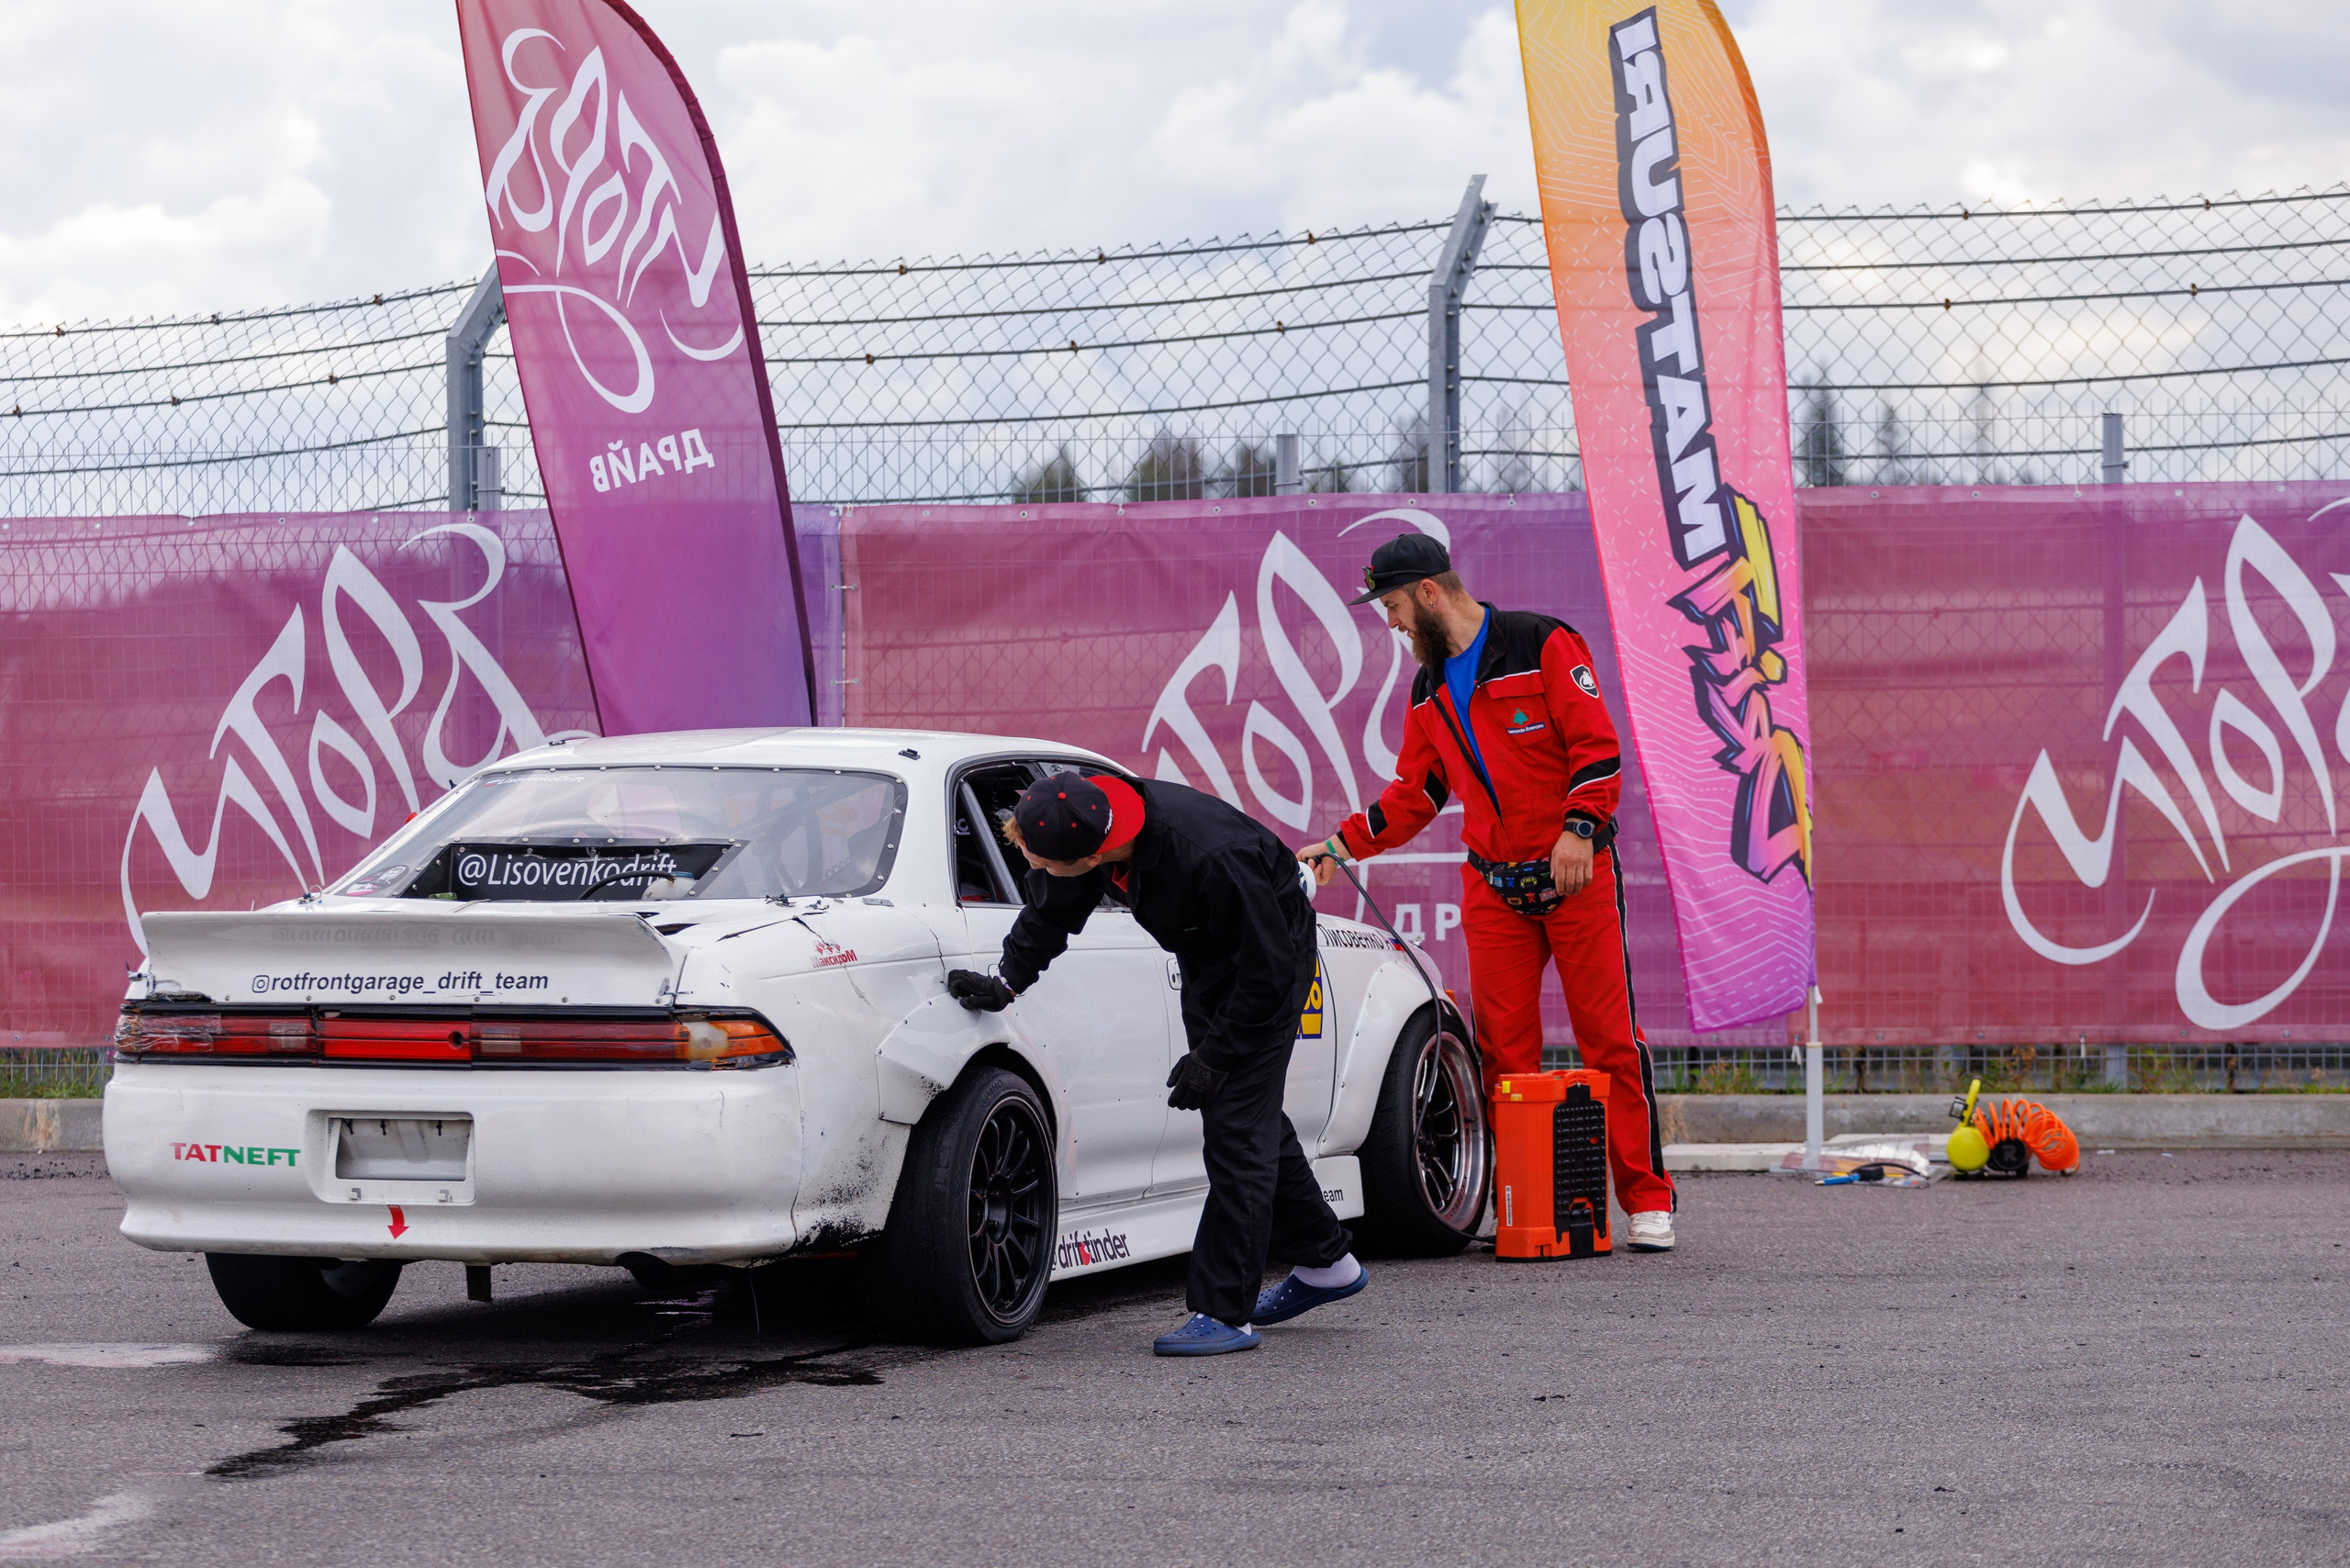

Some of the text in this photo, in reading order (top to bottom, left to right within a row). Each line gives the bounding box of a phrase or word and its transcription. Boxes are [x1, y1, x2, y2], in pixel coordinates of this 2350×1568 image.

[1393, 903, 1461, 942] ДР
[271, 971, 549, 994] rotfrontgarage_drift_team
[169, 1141, 302, 1168] TATNEFT
[1323, 1188, 1344, 1203] eam
[1052, 1228, 1131, 1271] driftinder
